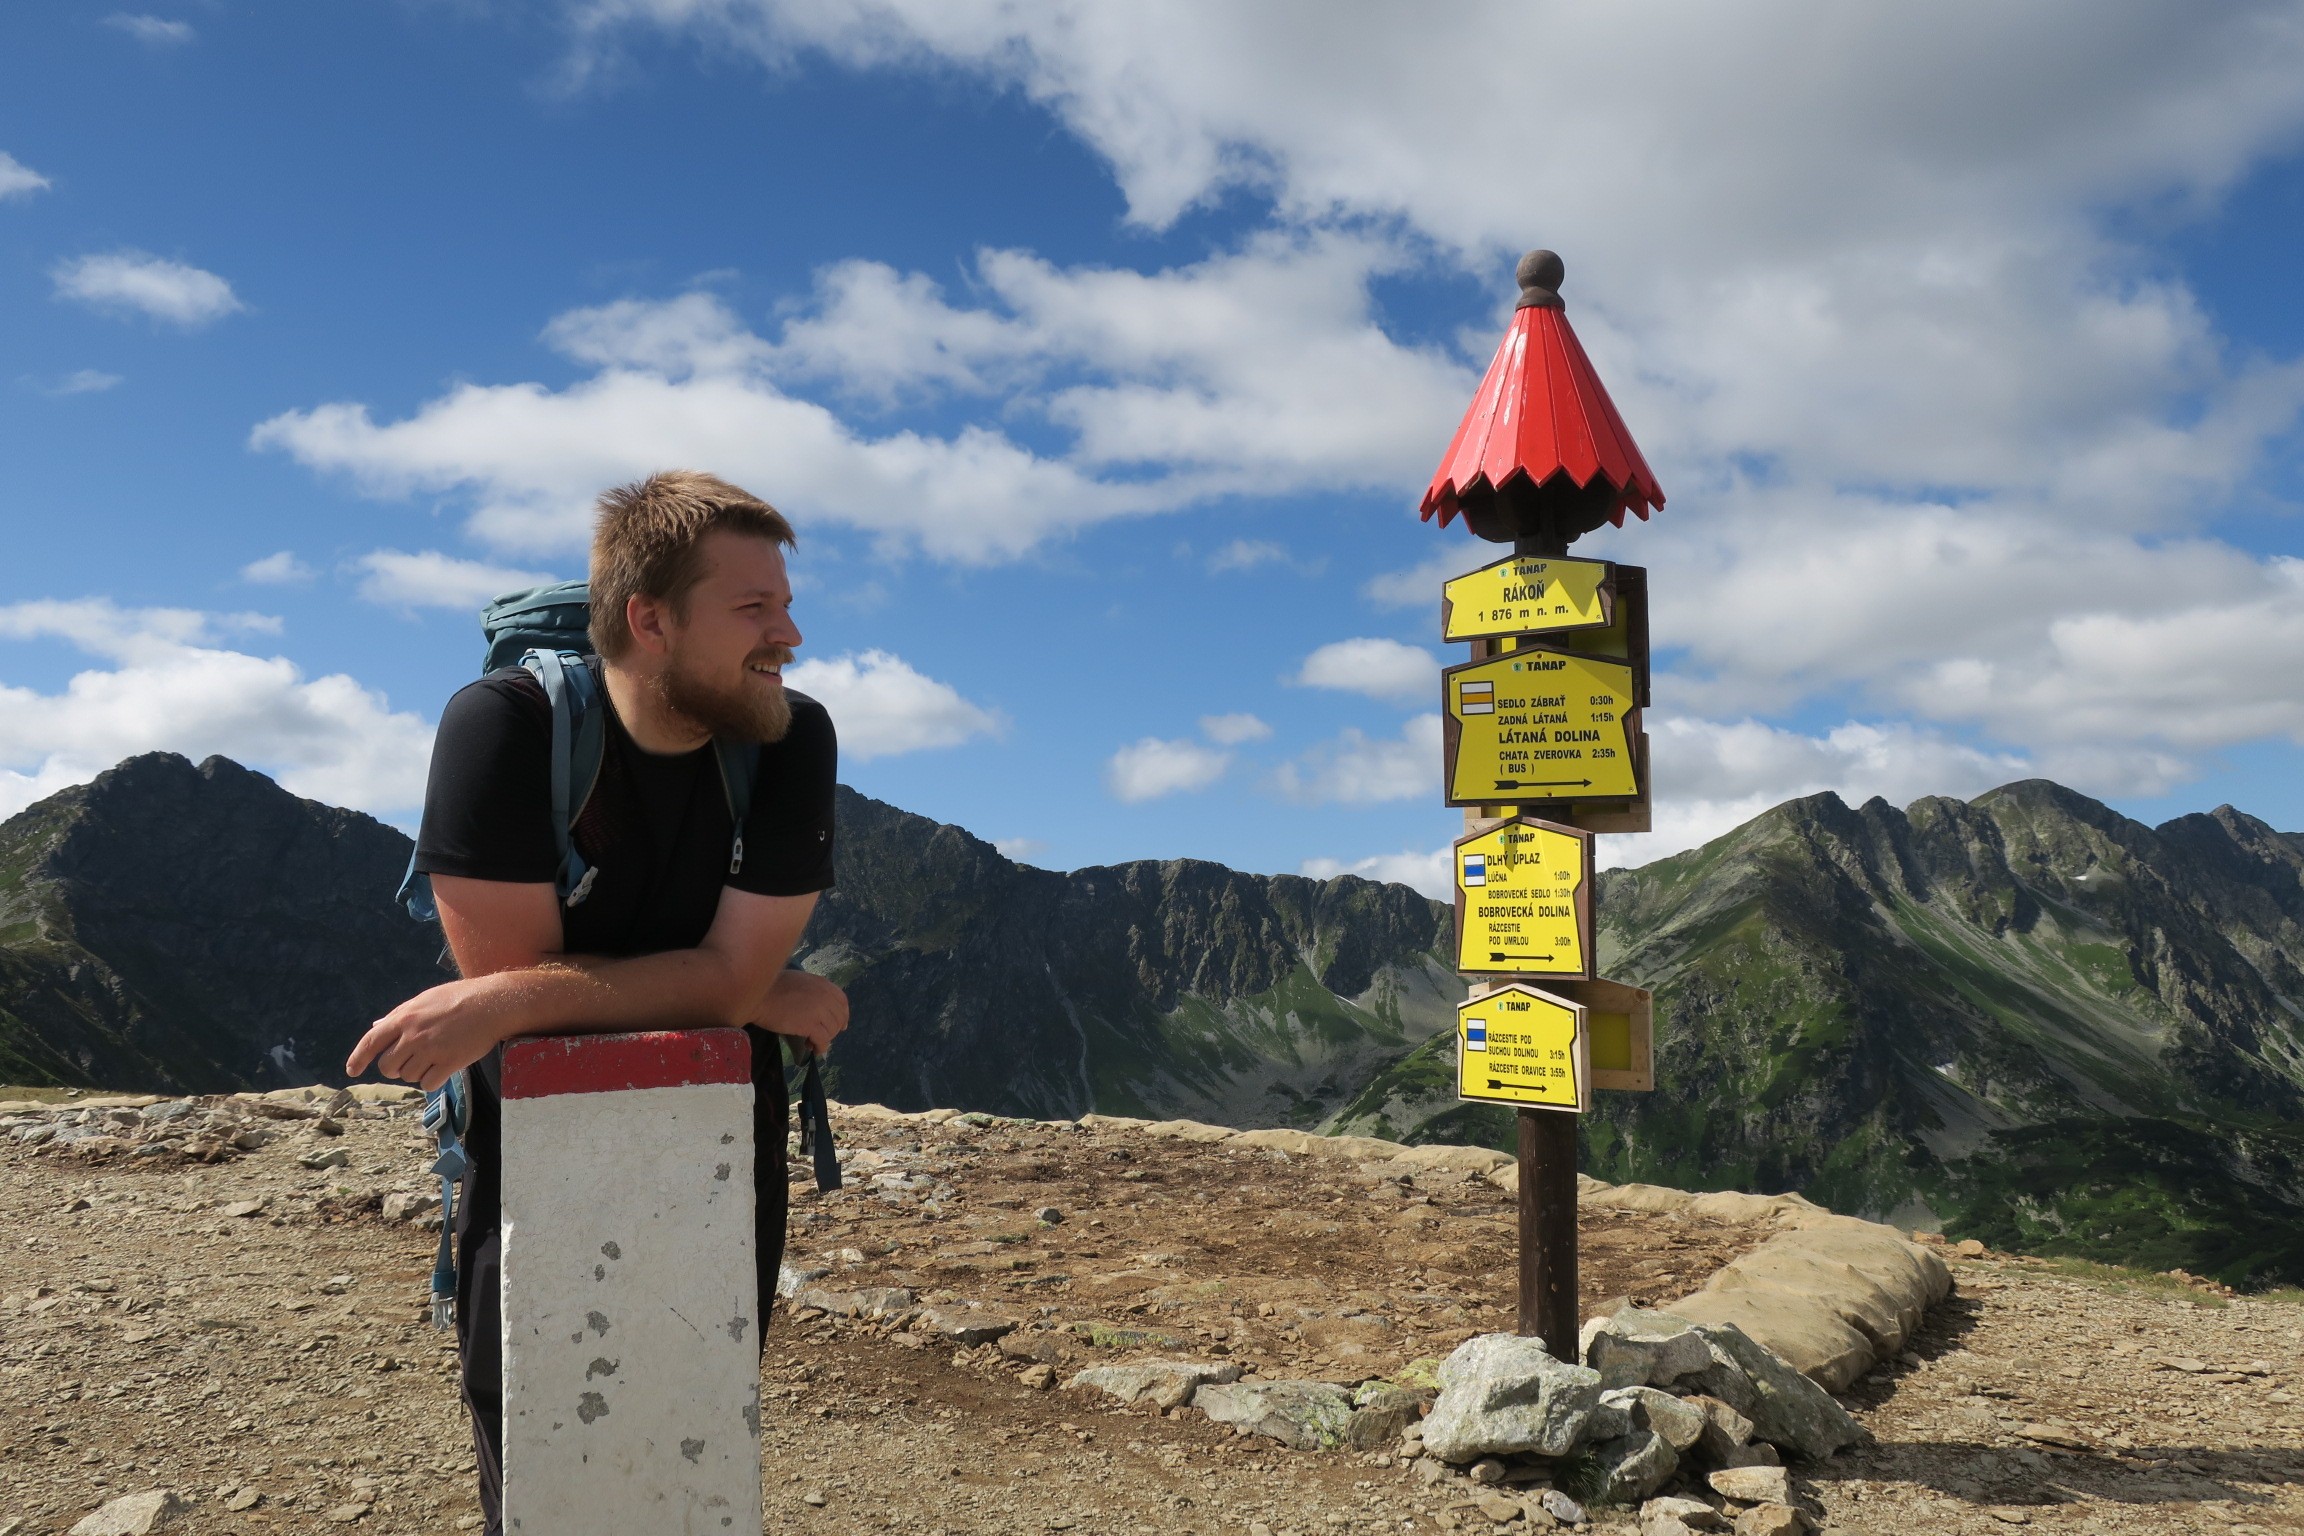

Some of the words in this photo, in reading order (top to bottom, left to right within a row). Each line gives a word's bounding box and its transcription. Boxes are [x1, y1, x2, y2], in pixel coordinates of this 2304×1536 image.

[1513, 564, 1548, 576] TANAP
[1504, 580, 1545, 603] RÁKOŇ
[1520, 609, 1530, 618] m
[1526, 660, 1566, 671] TANAP
[1498, 698, 1526, 709] SEDLO
[1531, 694, 1566, 708] ZÁBRAŤ
[1590, 695, 1614, 706] 0:30h
[1498, 713, 1528, 726] ZADNÁ
[1533, 712, 1568, 724] LÁTANÁ
[1590, 712, 1614, 722] 1:15h
[1498, 728, 1547, 744] LÁTANÁ
[1554, 730, 1600, 742] DOLINA
[1499, 750, 1529, 760] CHATA
[1534, 749, 1582, 760] ZVEROVKA
[1592, 748, 1616, 759] 2:35h
[1508, 764, 1526, 773] BUS
[1508, 833, 1536, 844] TANAP
[1487, 851, 1508, 866] DLHÝ
[1514, 850, 1540, 864] ÚPLAZ
[1488, 872, 1508, 882] LÚČNA
[1554, 870, 1570, 880] 1:00h
[1488, 887, 1528, 899] BOBROVECKÉ
[1531, 888, 1550, 899] SEDLO
[1554, 888, 1570, 898] 1:30h
[1478, 902, 1534, 918] BOBROVECKÁ
[1538, 906, 1570, 918] DOLINA
[1488, 921, 1520, 932] RÁZCESTIE
[1488, 936, 1500, 946] POD
[1504, 936, 1529, 946] UMRLOU
[1554, 936, 1571, 946] 3:00h
[1506, 1001, 1531, 1012] TANAP
[1488, 1030, 1518, 1044] RÁZCESTIE
[1520, 1034, 1532, 1044] POD
[1488, 1046, 1511, 1057] SUCHOU
[1514, 1048, 1538, 1058] DOLINOU
[1550, 1050, 1565, 1060] 3:15h
[1489, 1060, 1518, 1075] RÁZCESTIE
[1522, 1065, 1546, 1076] ORAVICE
[1550, 1067, 1566, 1078] 3:55h
